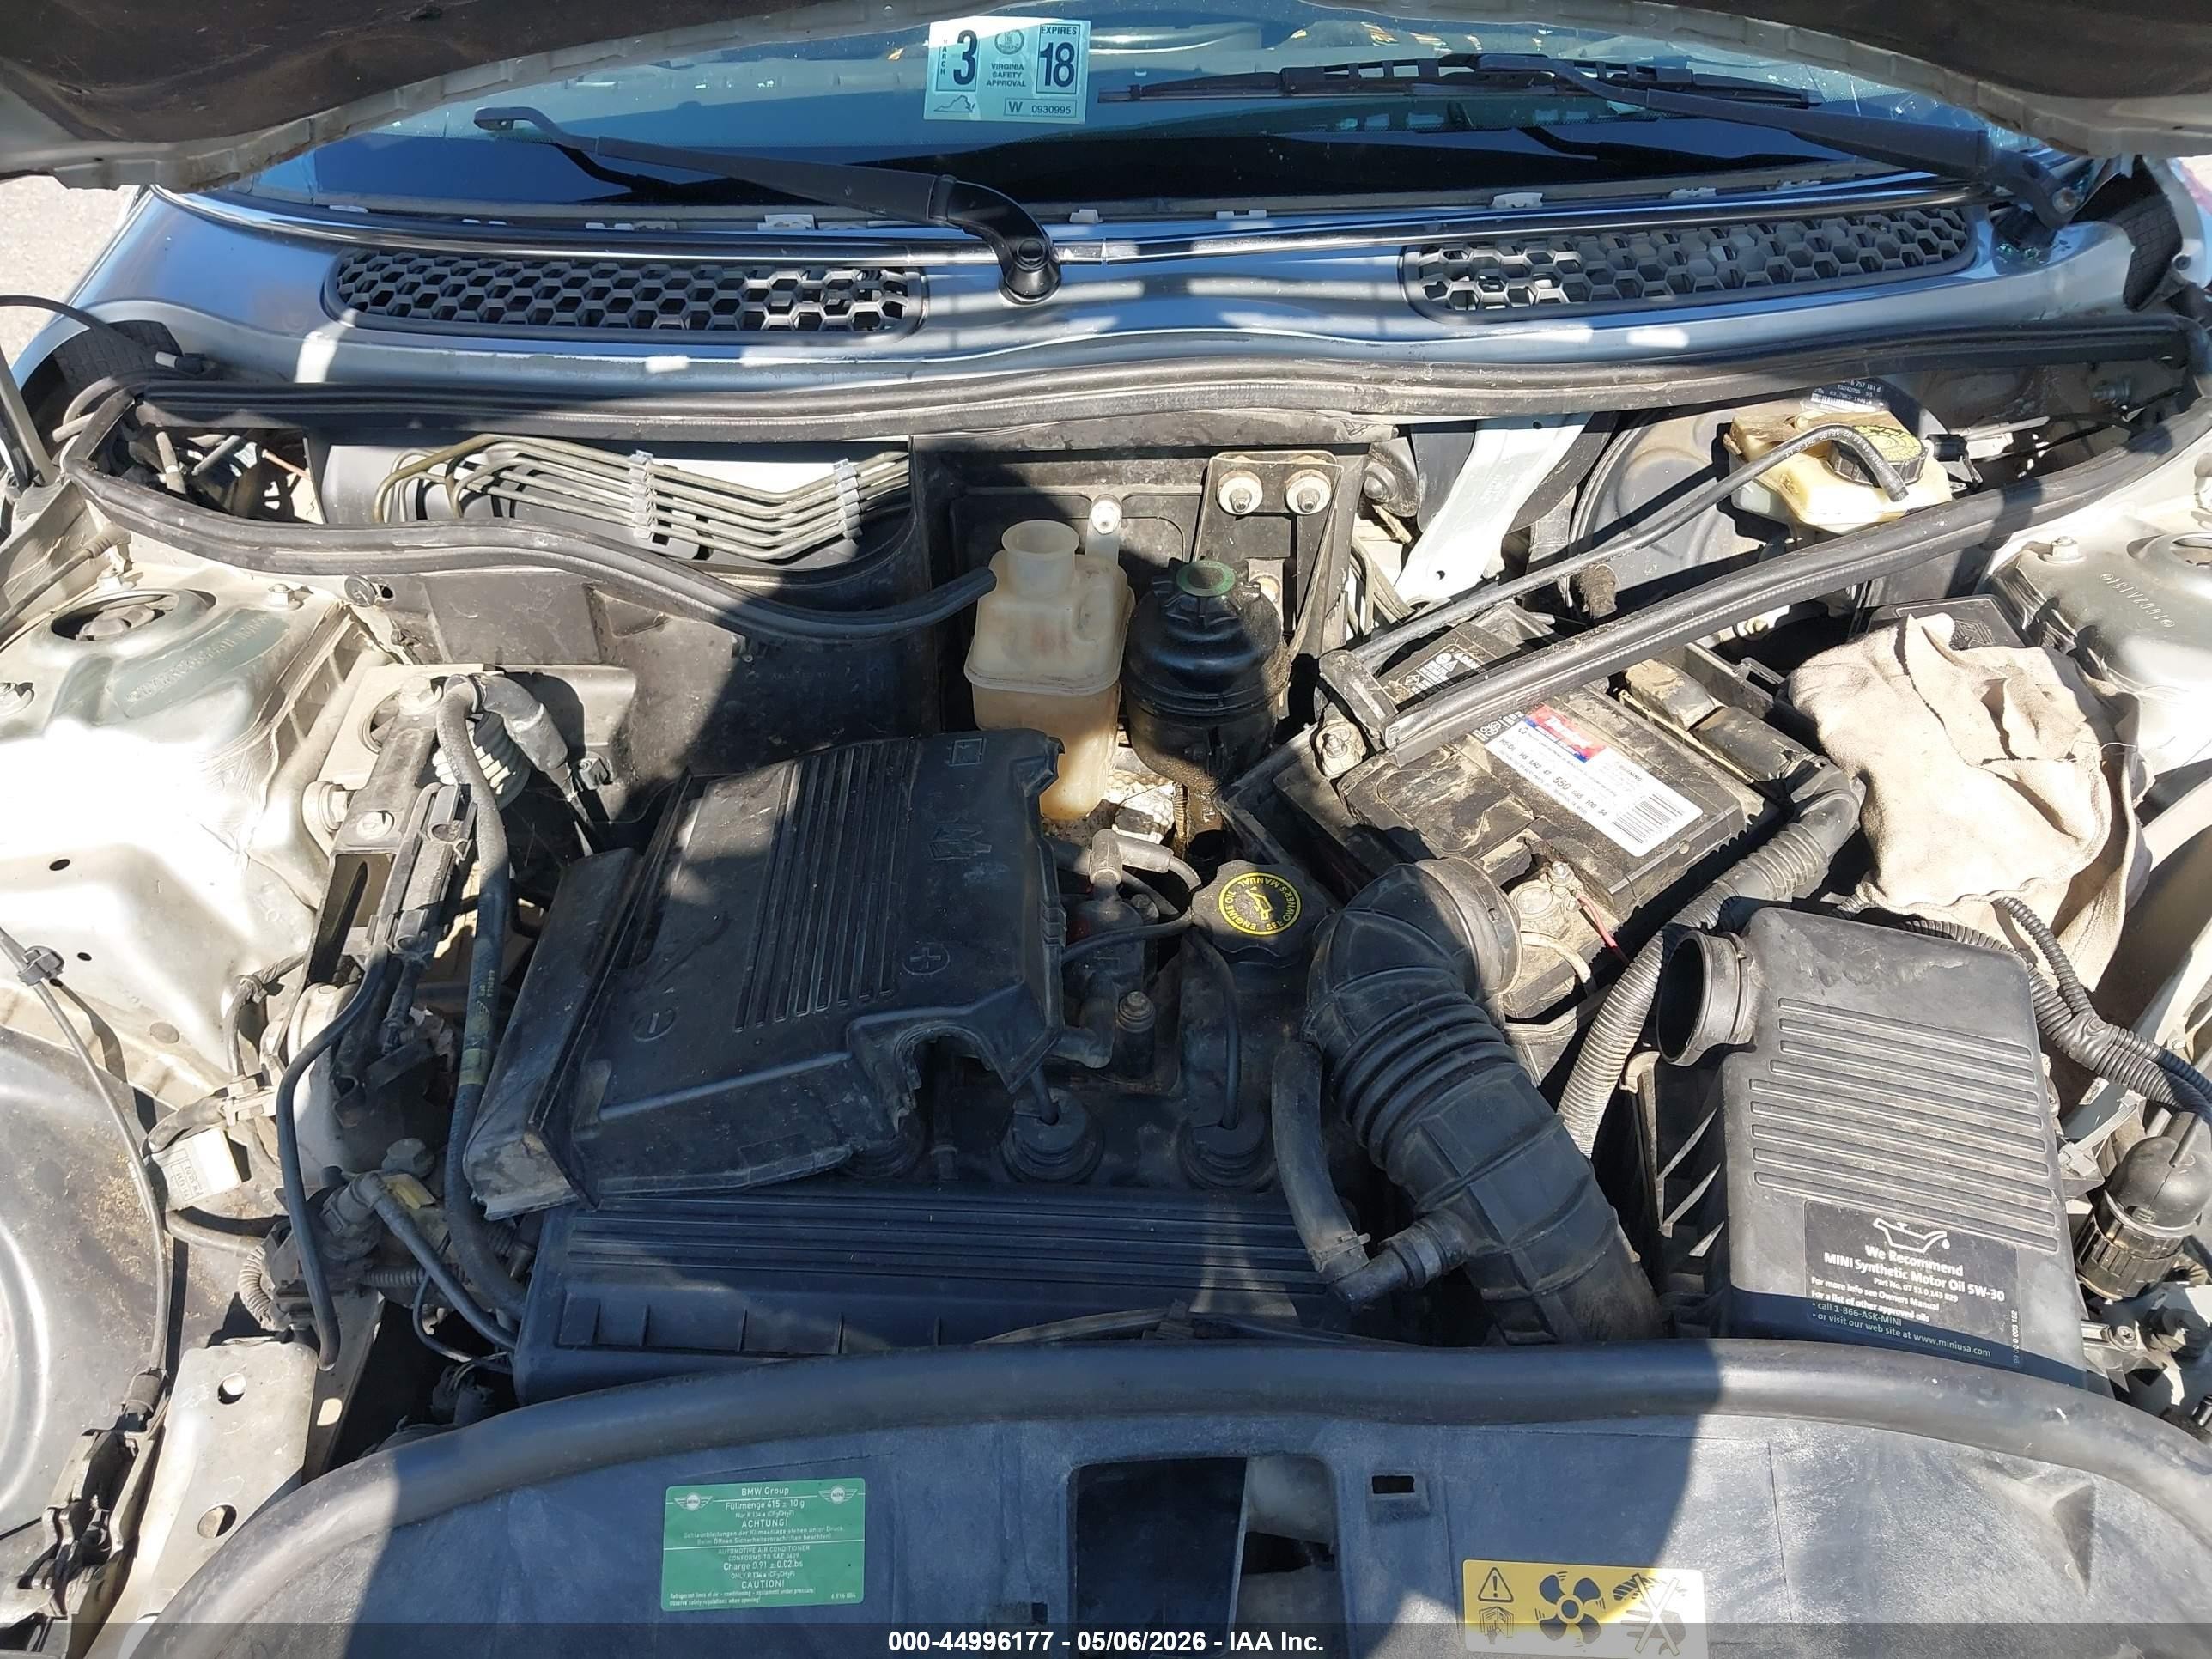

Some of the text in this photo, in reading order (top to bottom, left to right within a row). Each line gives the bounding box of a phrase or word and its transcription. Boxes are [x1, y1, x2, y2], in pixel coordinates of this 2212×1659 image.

[1041, 27, 1077, 35] EXPIRES
[953, 30, 977, 85] 3
[1040, 42, 1074, 88] 18
[1008, 101, 1023, 113] W
[1552, 774, 1572, 792] 550
[1237, 877, 1280, 889] MANUAL
[1224, 891, 1257, 931] ENGINE OIL
[1266, 920, 1285, 931] SEE
[1865, 1244, 1963, 1277] We Recommend
[1824, 1252, 2005, 1302] MINI Synthetic Motor Oil 5W-30
[1874, 1277, 1888, 1287] Part
[1811, 1276, 1824, 1286] For
[1825, 1280, 1846, 1291] more
[1864, 1289, 1877, 1297] see
[1878, 1291, 1908, 1304] Owners
[1909, 1297, 1940, 1310] Manual
[1811, 1290, 1825, 1299] For
[1832, 1293, 1844, 1304] list
[1845, 1297, 1856, 1306] of
[1856, 1300, 1878, 1311] other
[1878, 1304, 1915, 1319] approved
[1915, 1313, 1930, 1323] oils
[1817, 1302, 1902, 1326] call 1-866-ASK-MINI
[1828, 1315, 1847, 1325] visit
[1848, 1321, 1863, 1330] our
[1865, 1321, 1884, 1334] web
[1885, 1325, 1901, 1337] site
[1902, 1331, 1911, 1340] at
[1913, 1334, 1991, 1358] www.miniusa.com
[764, 1486, 789, 1495] Group
[767, 1499, 780, 1508] 415
[799, 1500, 805, 1509] g
[741, 1519, 788, 1528] ACHTUNG!
[723, 1562, 750, 1571] Charge
[752, 1560, 767, 1570] 0.91
[741, 1579, 785, 1589] CAUTION!
